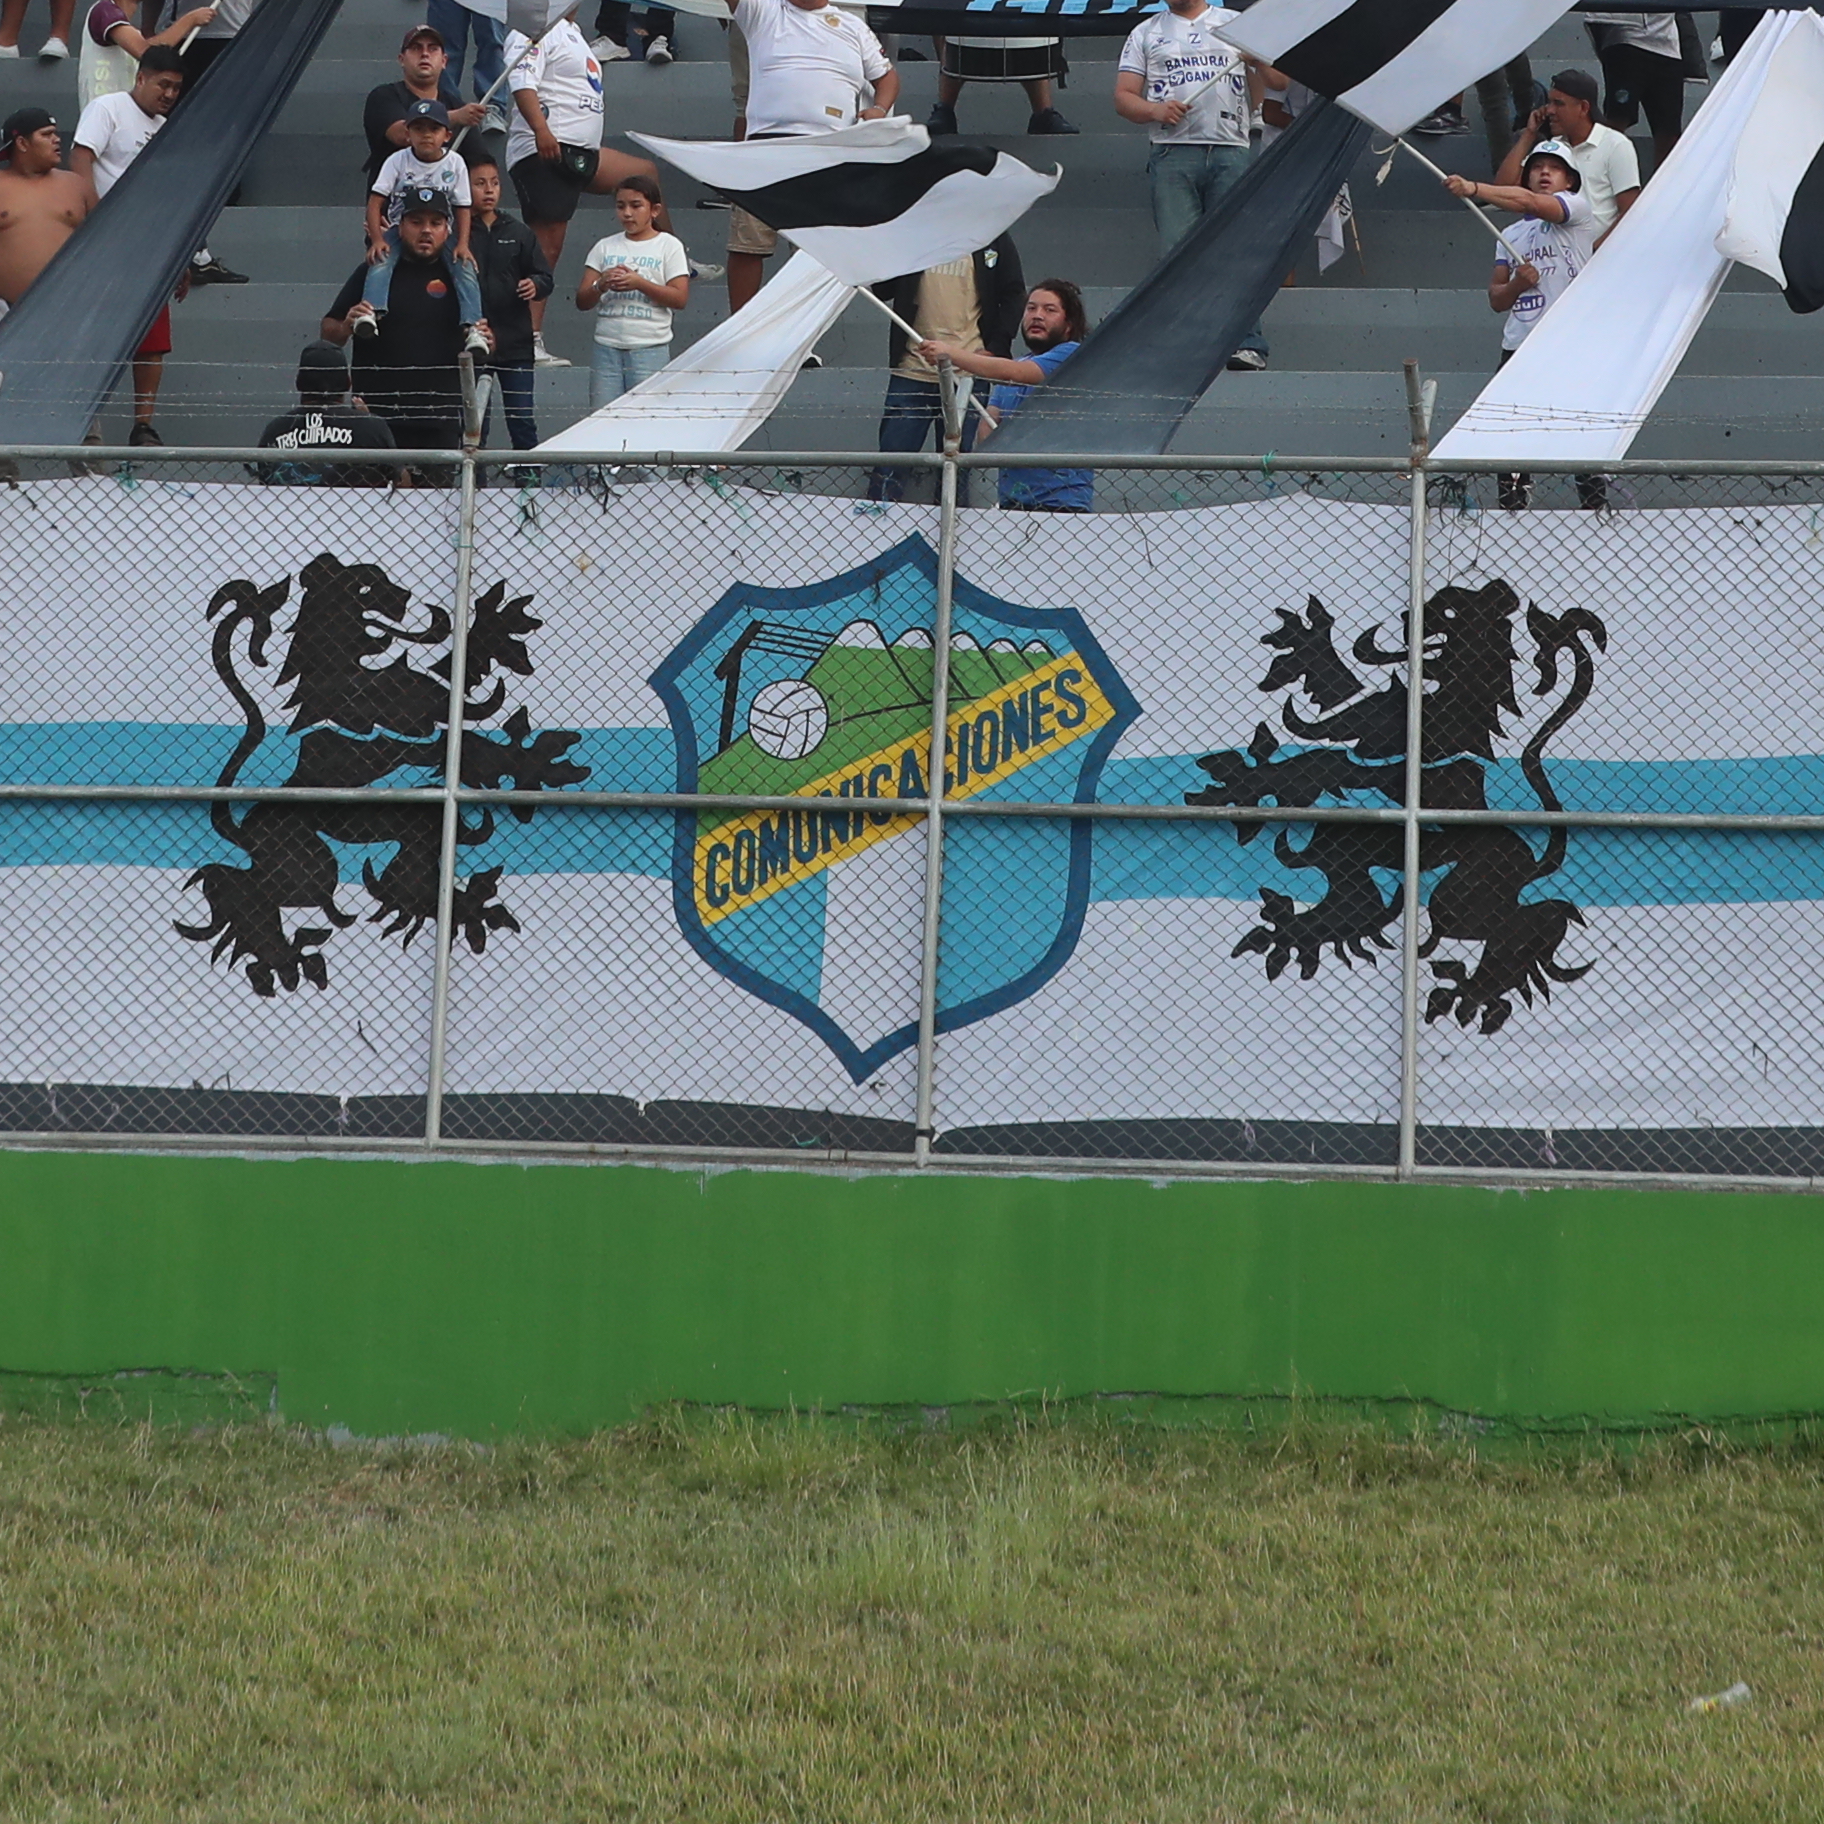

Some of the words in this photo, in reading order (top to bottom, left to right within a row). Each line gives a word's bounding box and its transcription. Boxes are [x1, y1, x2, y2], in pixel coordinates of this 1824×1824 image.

[579, 95, 605, 113] PEP
[1511, 294, 1546, 311] Gulf
[305, 412, 323, 428] LOS
[275, 430, 298, 449] TRES
[705, 669, 1086, 909] COMUNICACIONES
